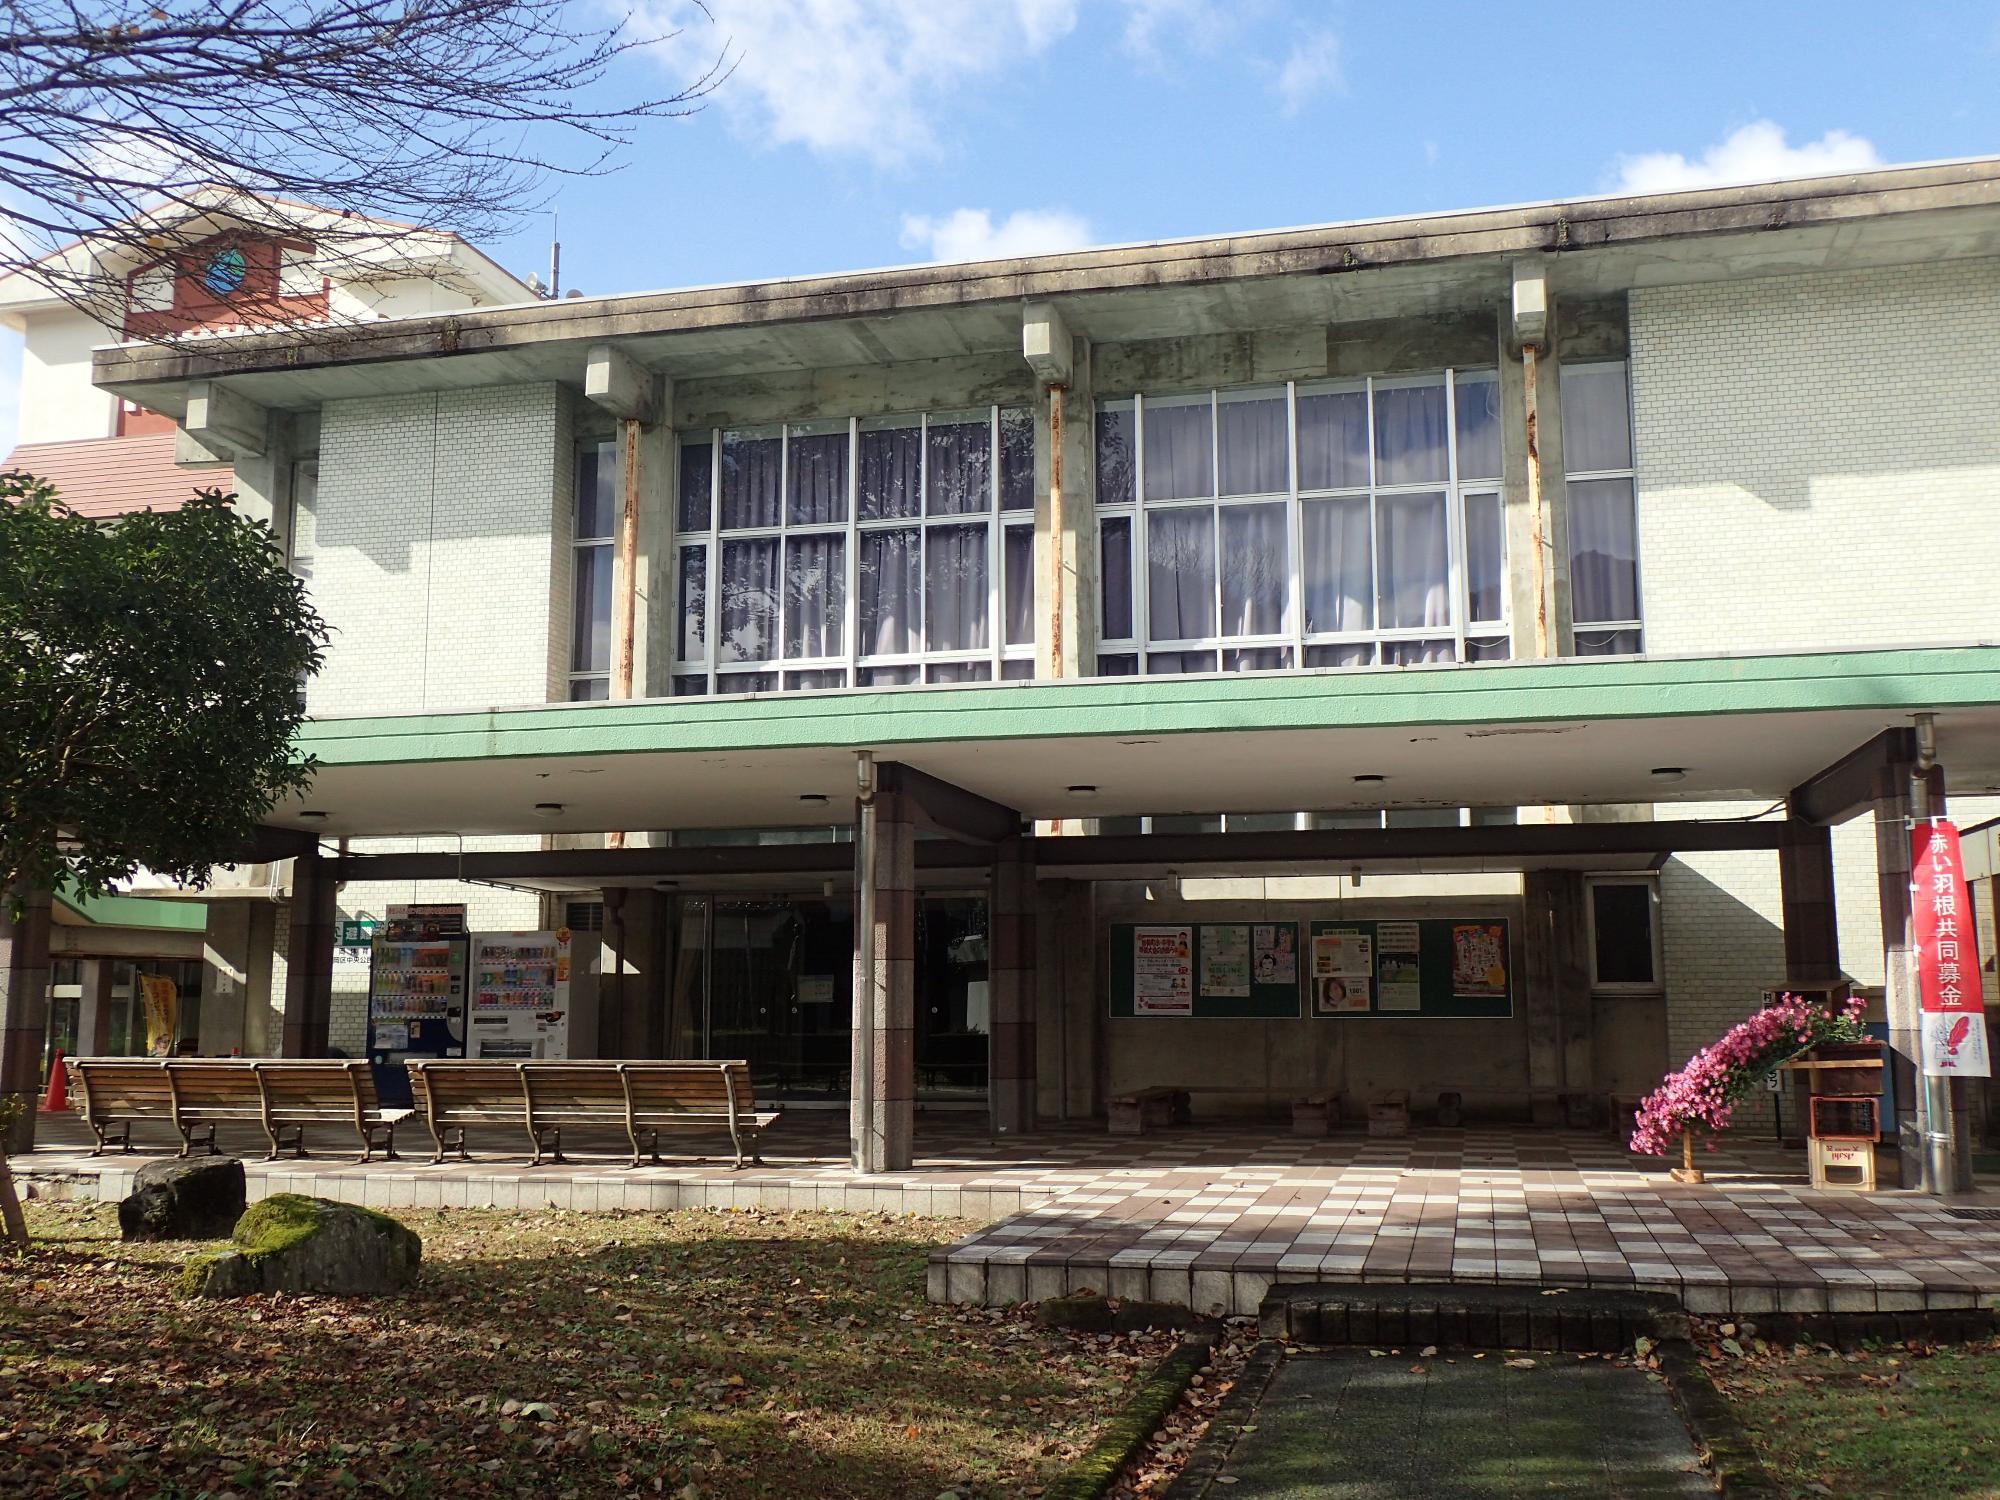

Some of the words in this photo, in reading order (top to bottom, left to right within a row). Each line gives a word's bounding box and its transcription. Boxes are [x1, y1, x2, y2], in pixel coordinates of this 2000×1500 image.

[1930, 833, 1962, 1006] 赤い羽根共同募金
[1831, 1152, 1855, 1161] Asahi
